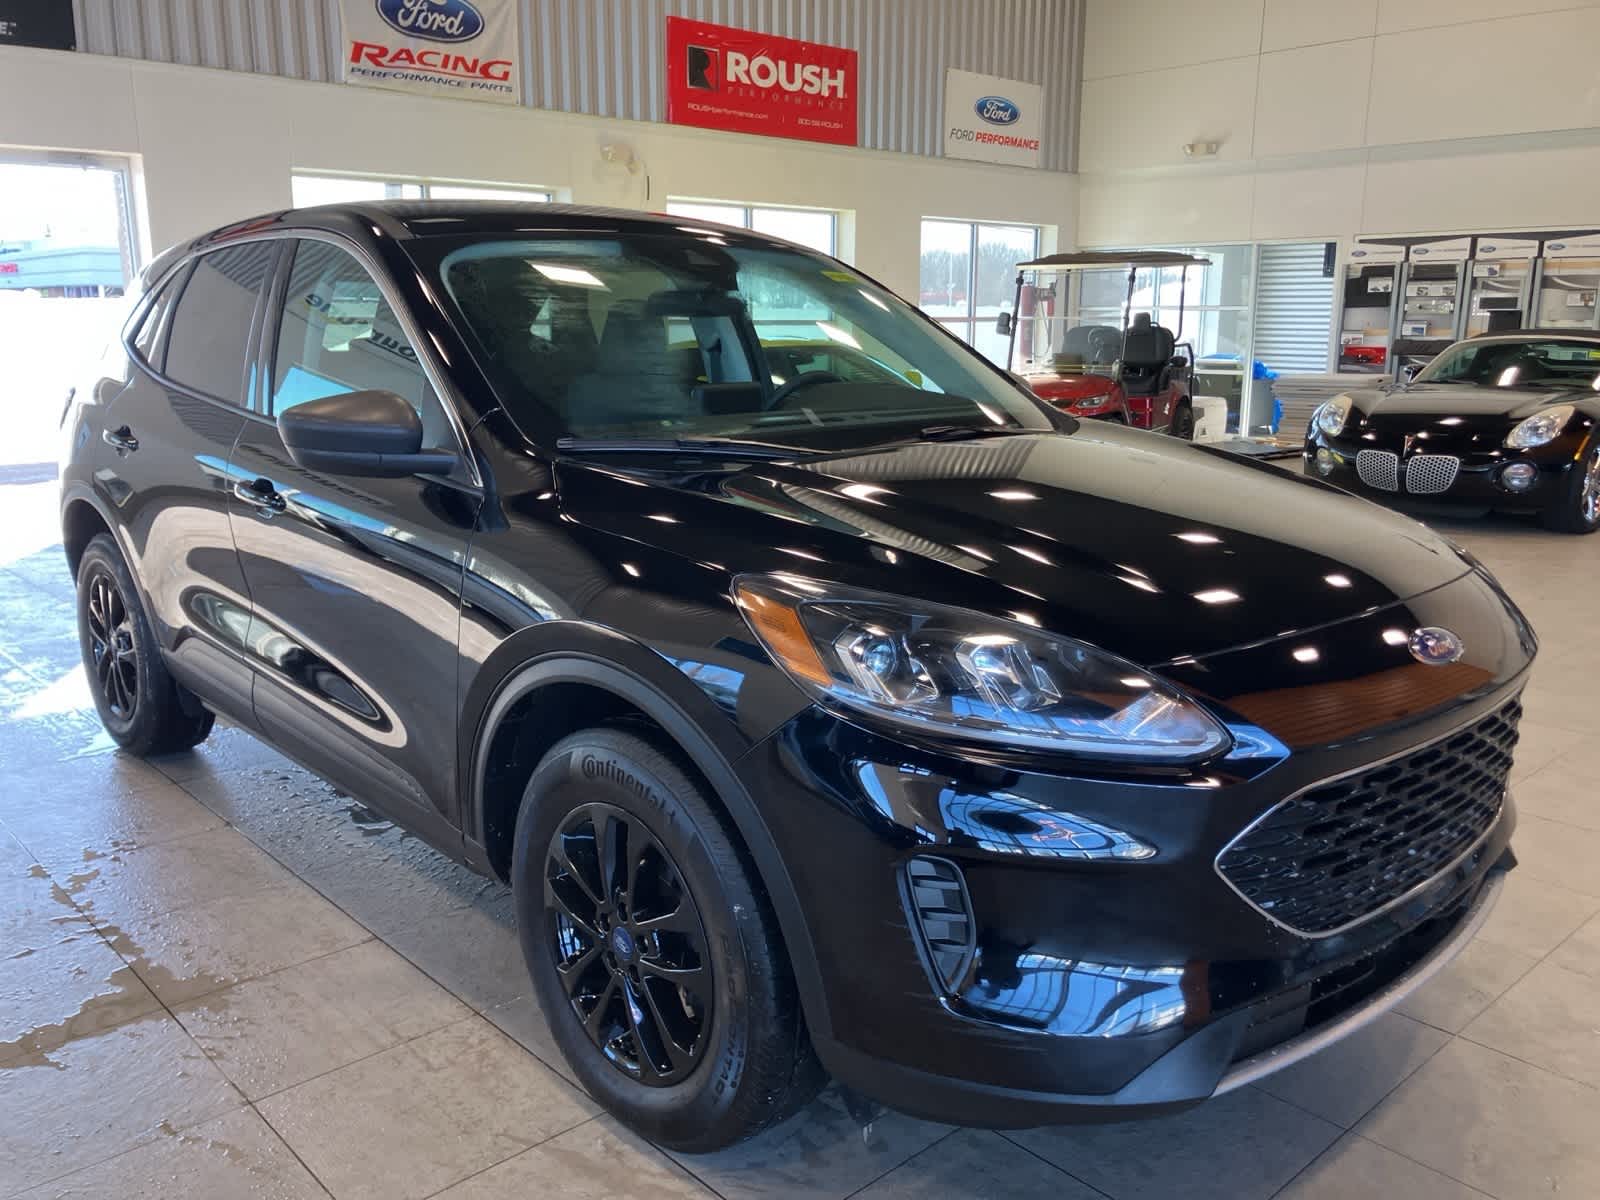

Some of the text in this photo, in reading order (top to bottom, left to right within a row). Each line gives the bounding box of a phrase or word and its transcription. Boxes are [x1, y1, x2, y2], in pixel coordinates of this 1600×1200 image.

[397, 0, 464, 36] Ford
[351, 41, 513, 81] RACING
[727, 50, 845, 98] ROUSH
[350, 66, 513, 93] PERFORMANCE PARTS
[983, 100, 1012, 121] Ford
[950, 128, 1039, 150] FORD PERFORMANCE
[582, 754, 667, 810] Continental
